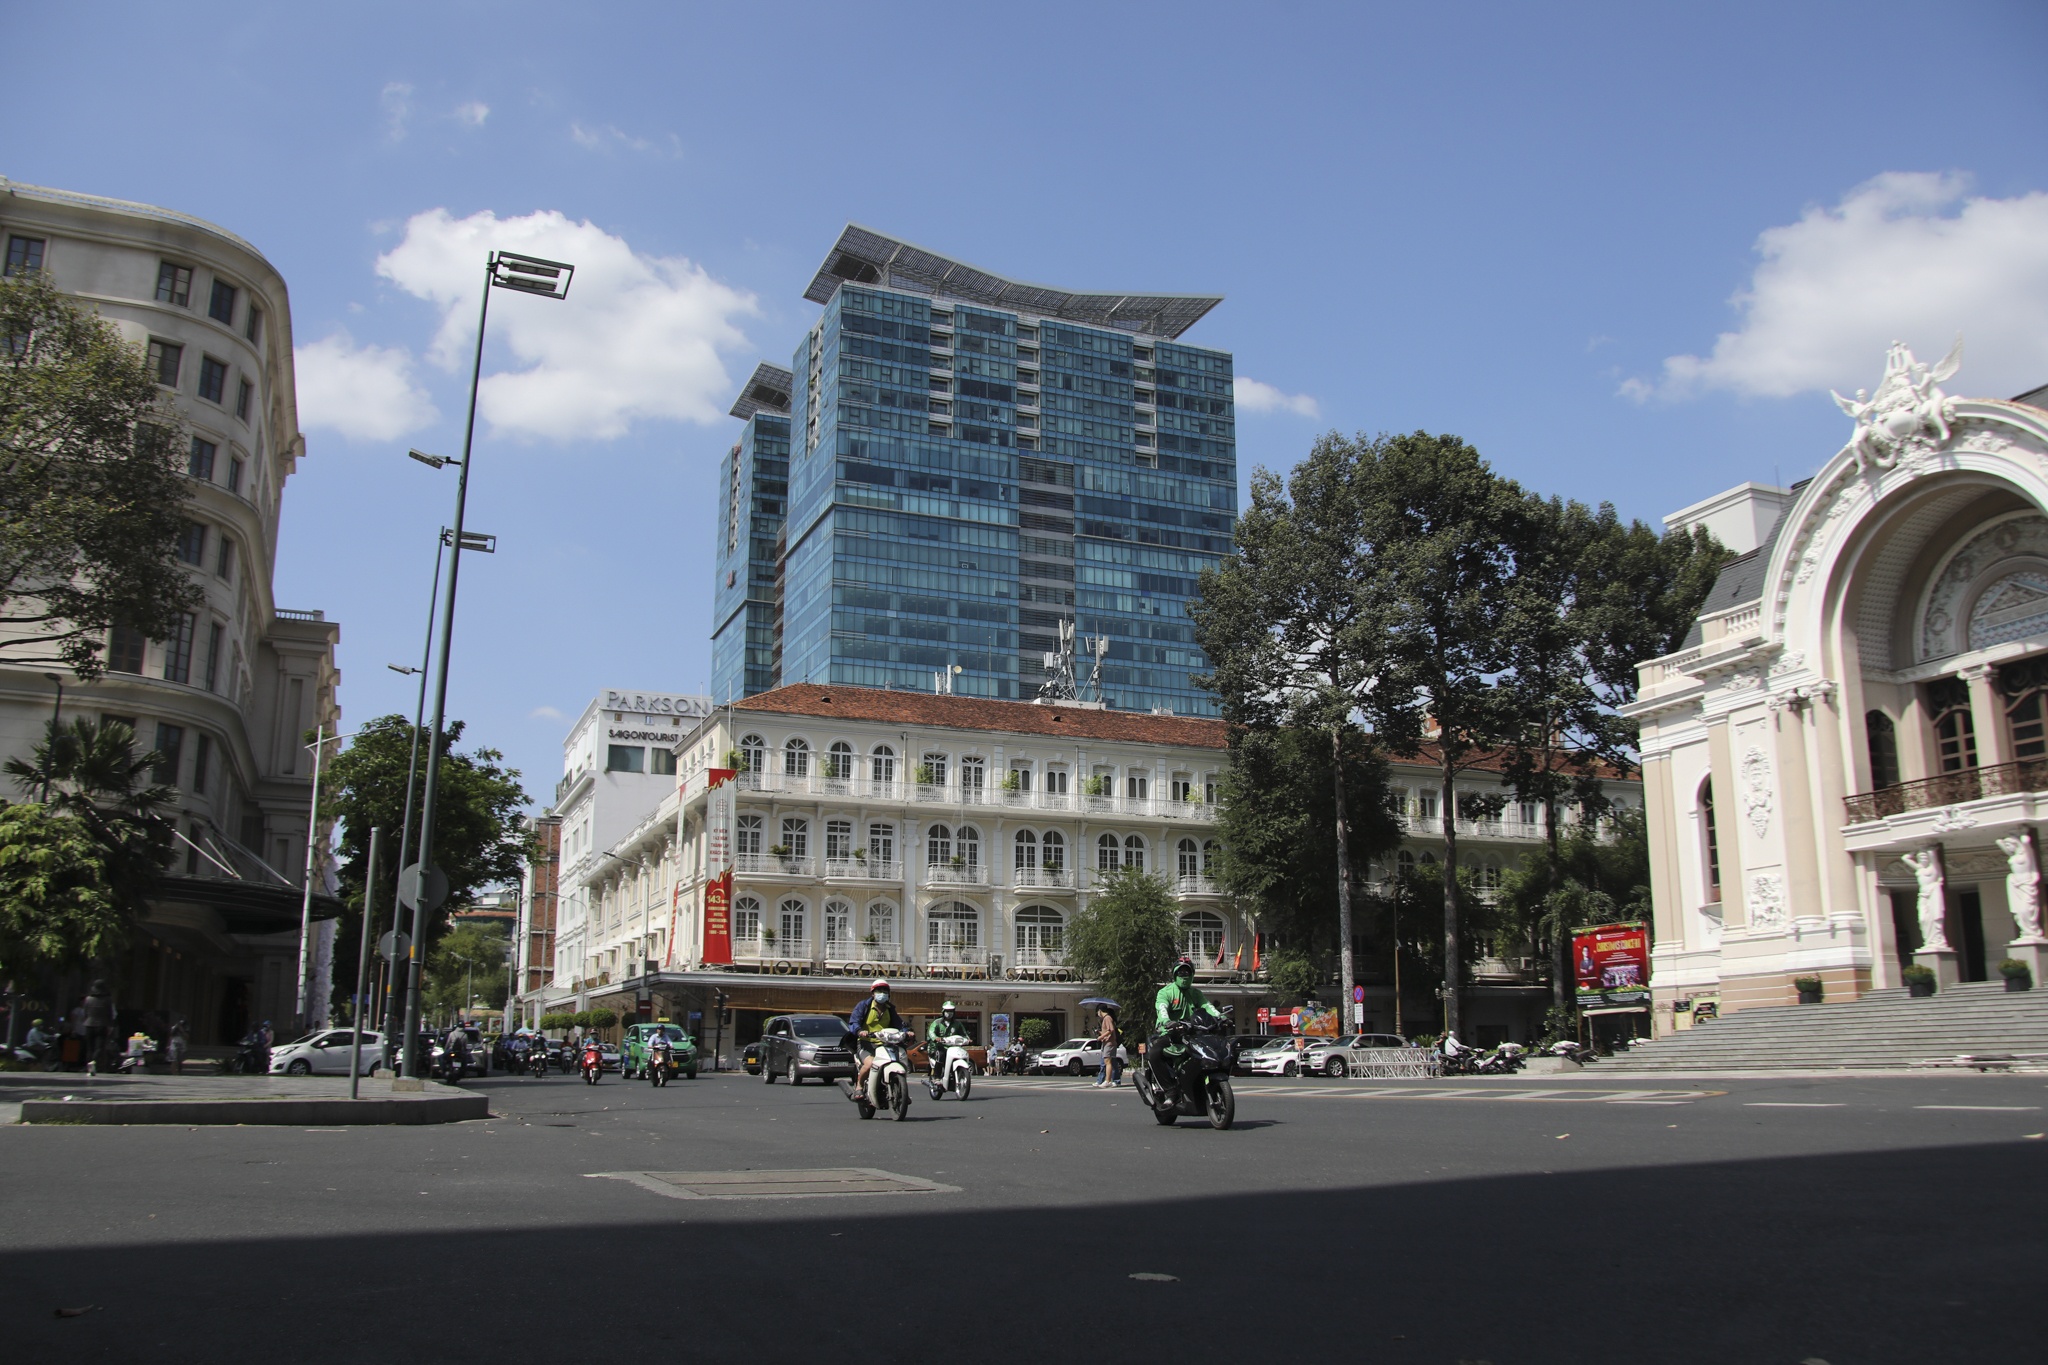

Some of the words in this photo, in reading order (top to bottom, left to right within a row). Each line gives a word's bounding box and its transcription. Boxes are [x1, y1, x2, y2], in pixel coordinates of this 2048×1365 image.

[607, 691, 709, 714] PARKSON
[609, 729, 678, 742] SAIGONTOURIST
[707, 895, 721, 904] 143
[1005, 967, 1084, 983] SAIGON
